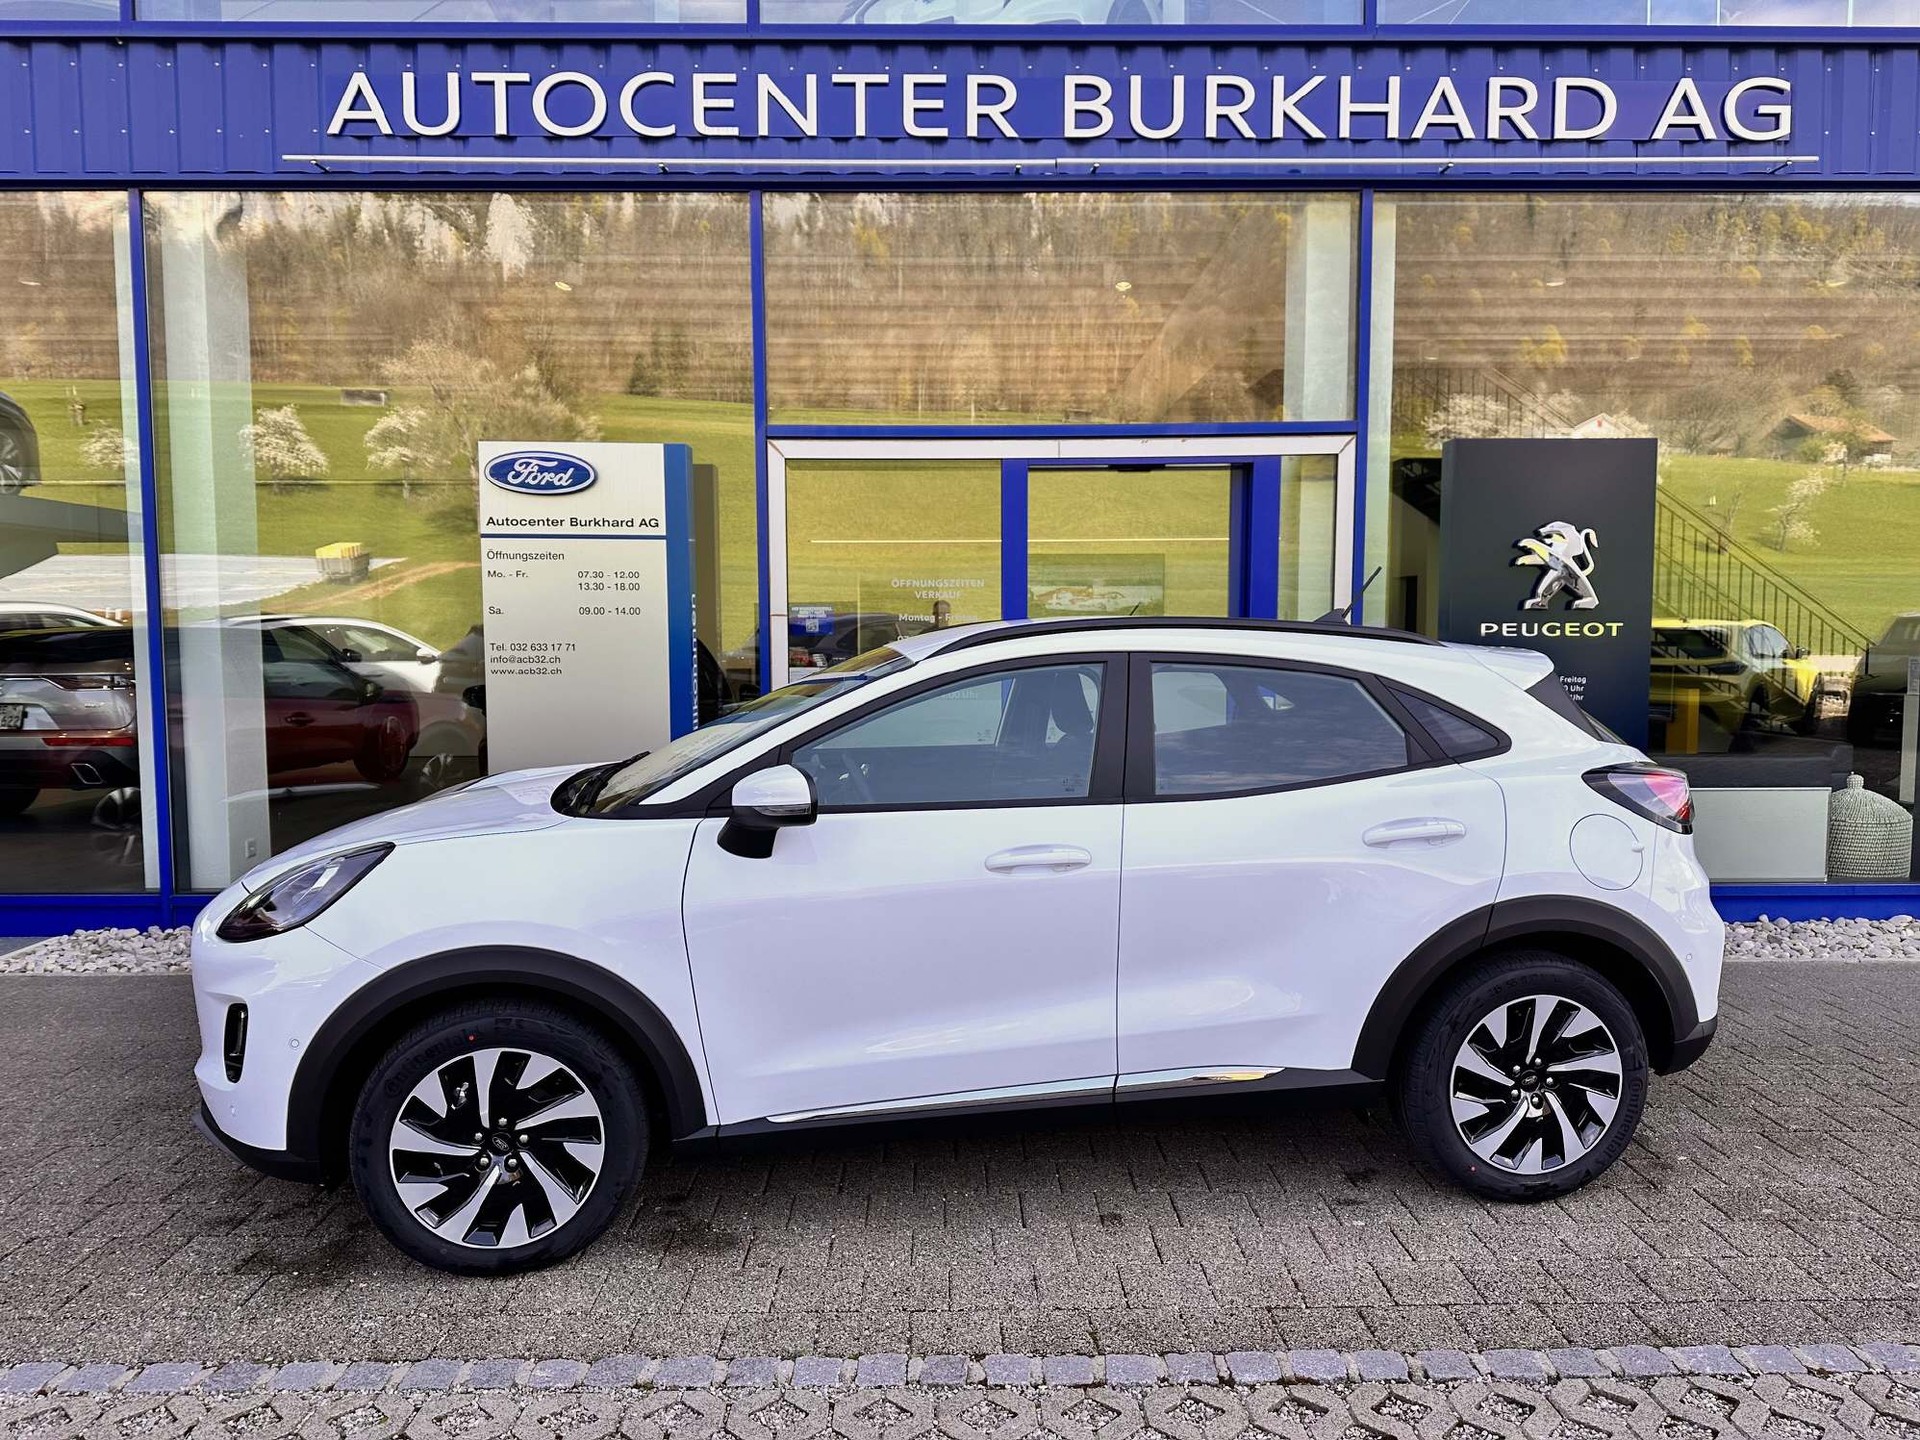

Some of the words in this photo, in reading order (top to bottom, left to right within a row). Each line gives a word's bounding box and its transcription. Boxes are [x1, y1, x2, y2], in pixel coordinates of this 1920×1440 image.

[327, 70, 1019, 138] AUTOCENTER
[1063, 74, 1619, 141] BURKHARD
[1650, 76, 1794, 142] AG
[506, 458, 575, 487] Ford
[485, 515, 566, 528] Autocenter
[569, 516, 635, 528] Burkhard
[638, 517, 660, 528] AG
[486, 549, 565, 562] Öffnungszeiten
[487, 570, 506, 578] Mo.
[515, 570, 529, 578] Fr.
[577, 571, 604, 579] 07.30
[613, 571, 640, 579] 12.00
[577, 582, 604, 591] 13.30
[614, 583, 640, 591] 18.00
[891, 577, 985, 588] ÖFFNUNGSZEITEN
[488, 606, 504, 615] Sa.
[578, 606, 605, 615] 09.00
[615, 607, 641, 615] 14.00
[898, 613, 936, 623] Montag
[1480, 622, 1624, 637] PEUGEOT
[489, 642, 507, 652] Tel.
[509, 642, 528, 652] 032
[530, 643, 549, 652] 633
[551, 643, 563, 652] 17
[565, 643, 576, 652] 71
[490, 655, 561, 664] info@acb32.ch
[691, 593, 699, 731] illkommen
[490, 666, 562, 675] www.acb32.ch
[1560, 676, 1587, 684] Freitag
